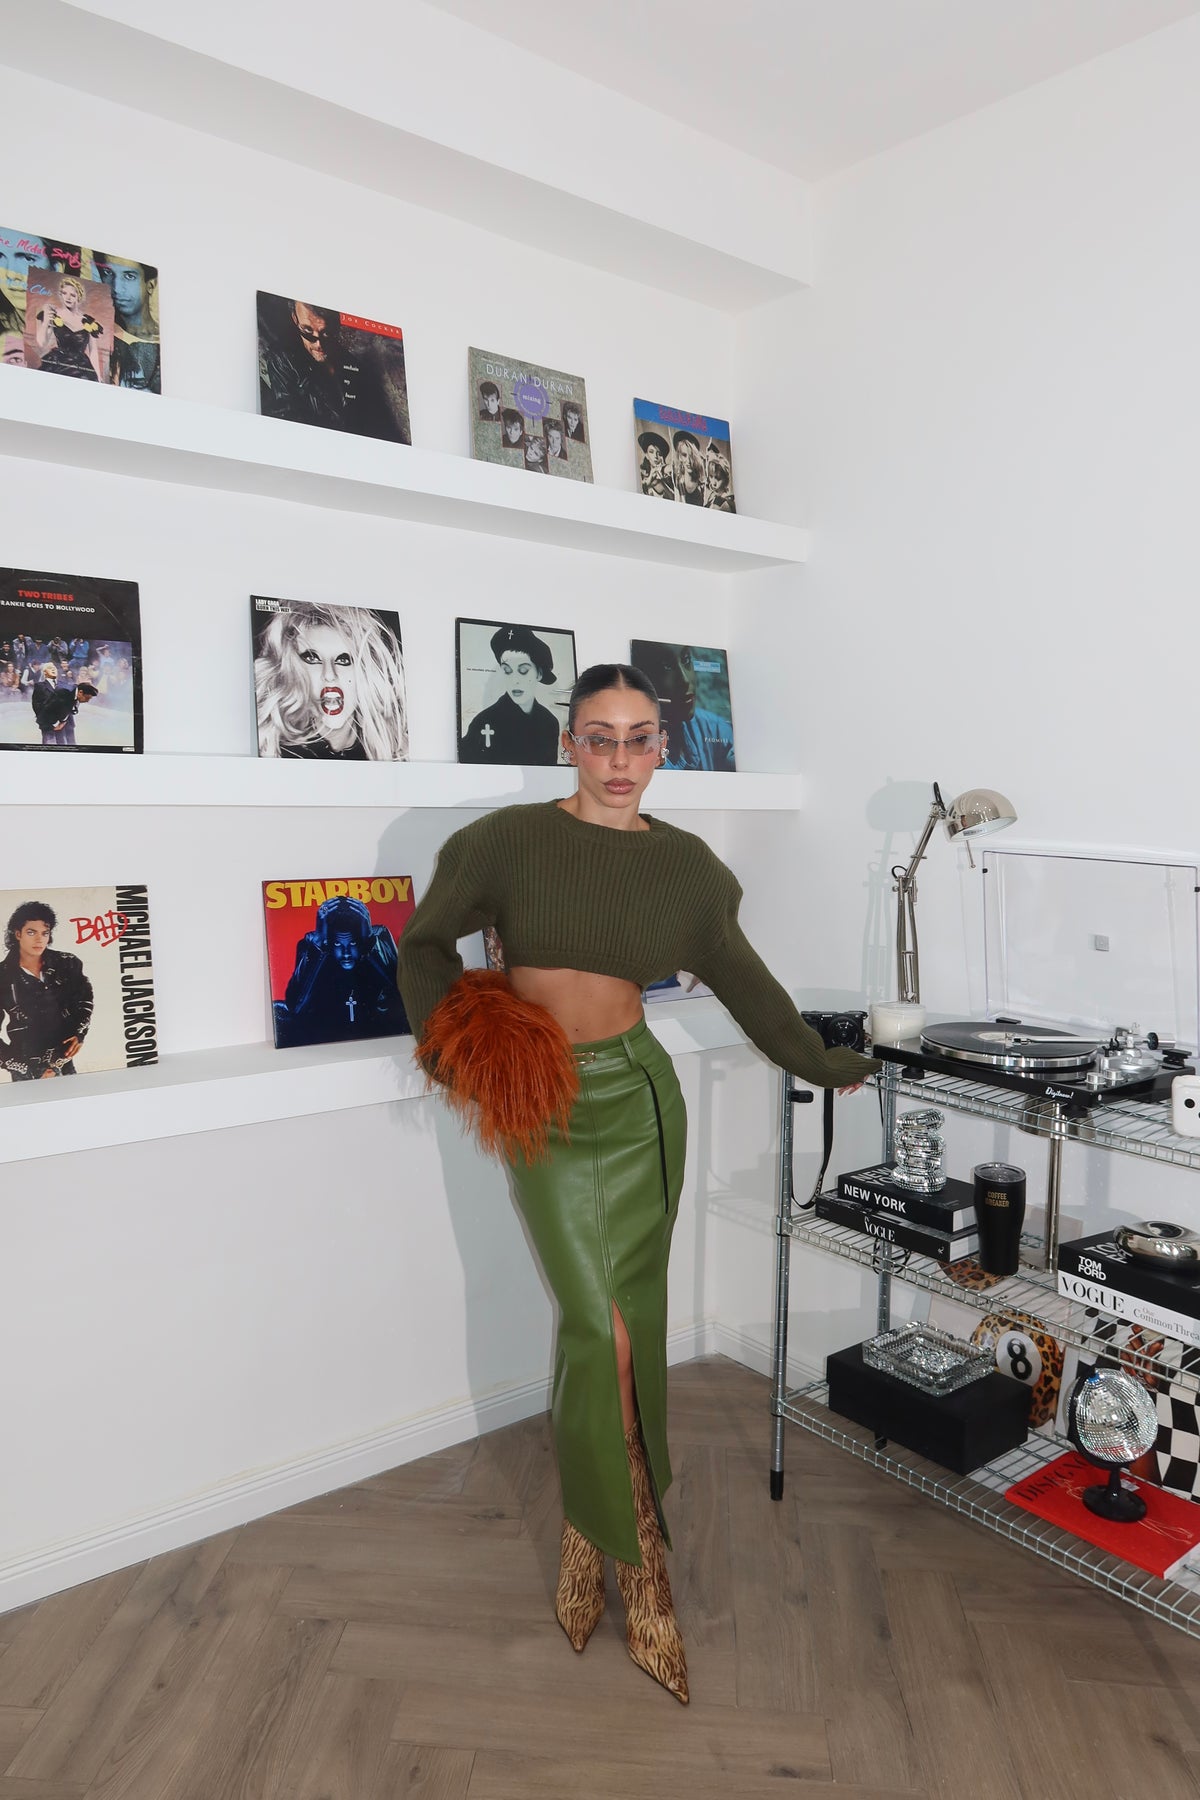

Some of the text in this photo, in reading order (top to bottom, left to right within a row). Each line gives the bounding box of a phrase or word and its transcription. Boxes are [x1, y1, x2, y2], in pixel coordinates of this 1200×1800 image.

[486, 363, 528, 384] DURAN
[533, 376, 574, 395] DURAN
[18, 589, 40, 599] TWO
[42, 591, 75, 602] TRIBES
[56, 605, 95, 614] HOLLYWOOD
[266, 878, 411, 909] STARBOY
[69, 910, 128, 947] BAD
[116, 885, 159, 1068] MICHAEL JACKSON
[844, 1183, 907, 1214] NEW YORK
[987, 1191, 1008, 1200] COFFEE
[864, 1215, 896, 1242] VOGUE
[1078, 1255, 1102, 1271] TOM
[1078, 1263, 1107, 1281] FORD
[1061, 1276, 1125, 1314] VOGUE
[1133, 1307, 1174, 1331] Common
